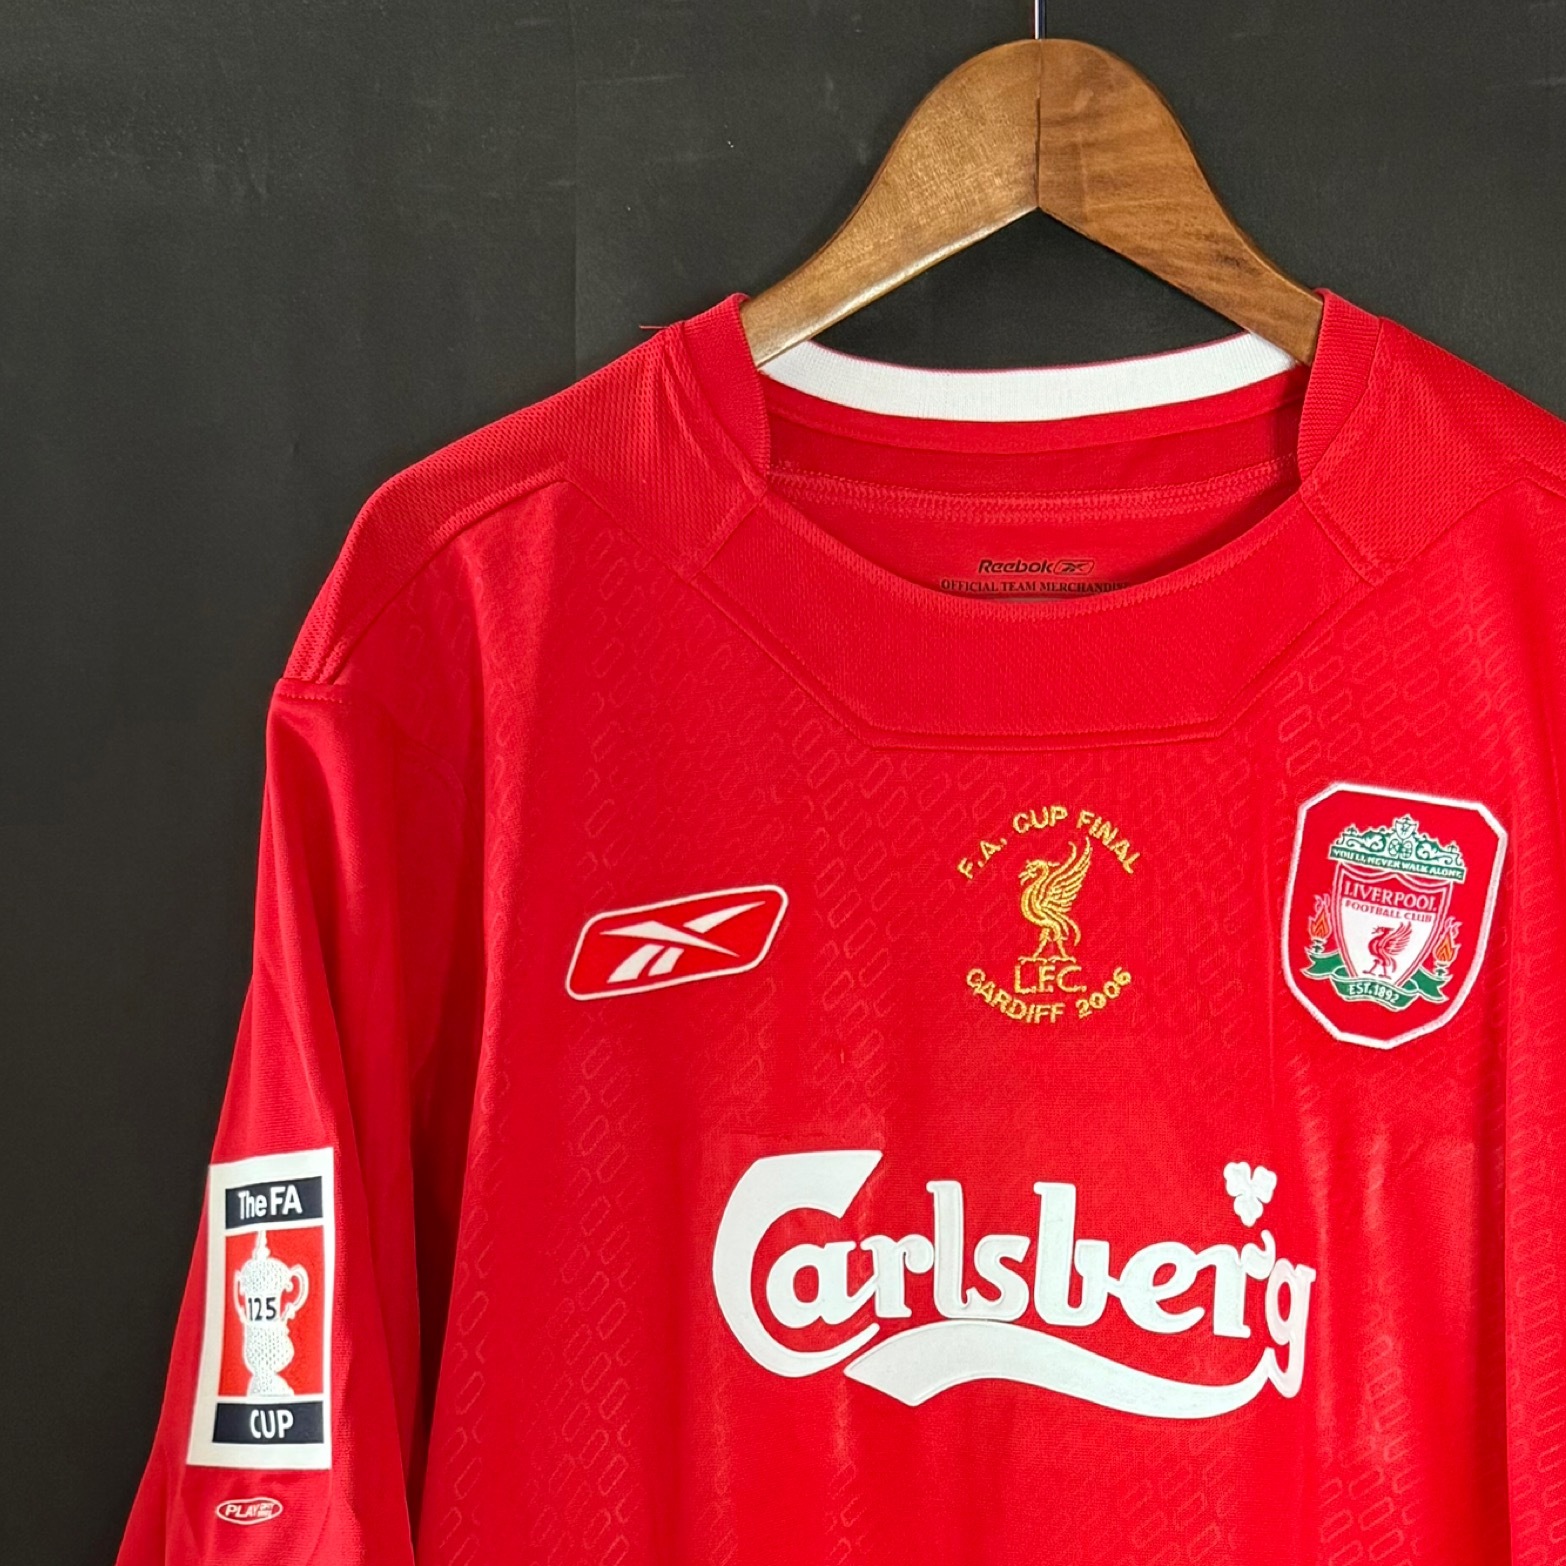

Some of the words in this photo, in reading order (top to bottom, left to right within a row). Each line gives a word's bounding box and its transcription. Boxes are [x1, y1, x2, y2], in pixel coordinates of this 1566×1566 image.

[978, 559, 1053, 574] Reebok
[941, 579, 998, 593] OFFICIAL
[1000, 580, 1036, 592] TEAM
[1013, 805, 1068, 834] CUP
[1076, 810, 1140, 874] FINAL
[1367, 856, 1400, 869] NEVER
[1402, 863, 1428, 873] WALK
[1344, 880, 1437, 911] LIVERPOOL
[1345, 900, 1402, 919] FOOTBALL
[1403, 911, 1432, 923] CLUB
[966, 968, 1066, 1023] CARDIFF
[1075, 967, 1132, 1019] 2006
[238, 1190, 268, 1220] The
[269, 1186, 302, 1216] FA
[712, 1149, 1316, 1418] Carlsberg
[248, 1297, 277, 1321] 125
[250, 1408, 293, 1438] CUP
[225, 1504, 260, 1518] PLAY
